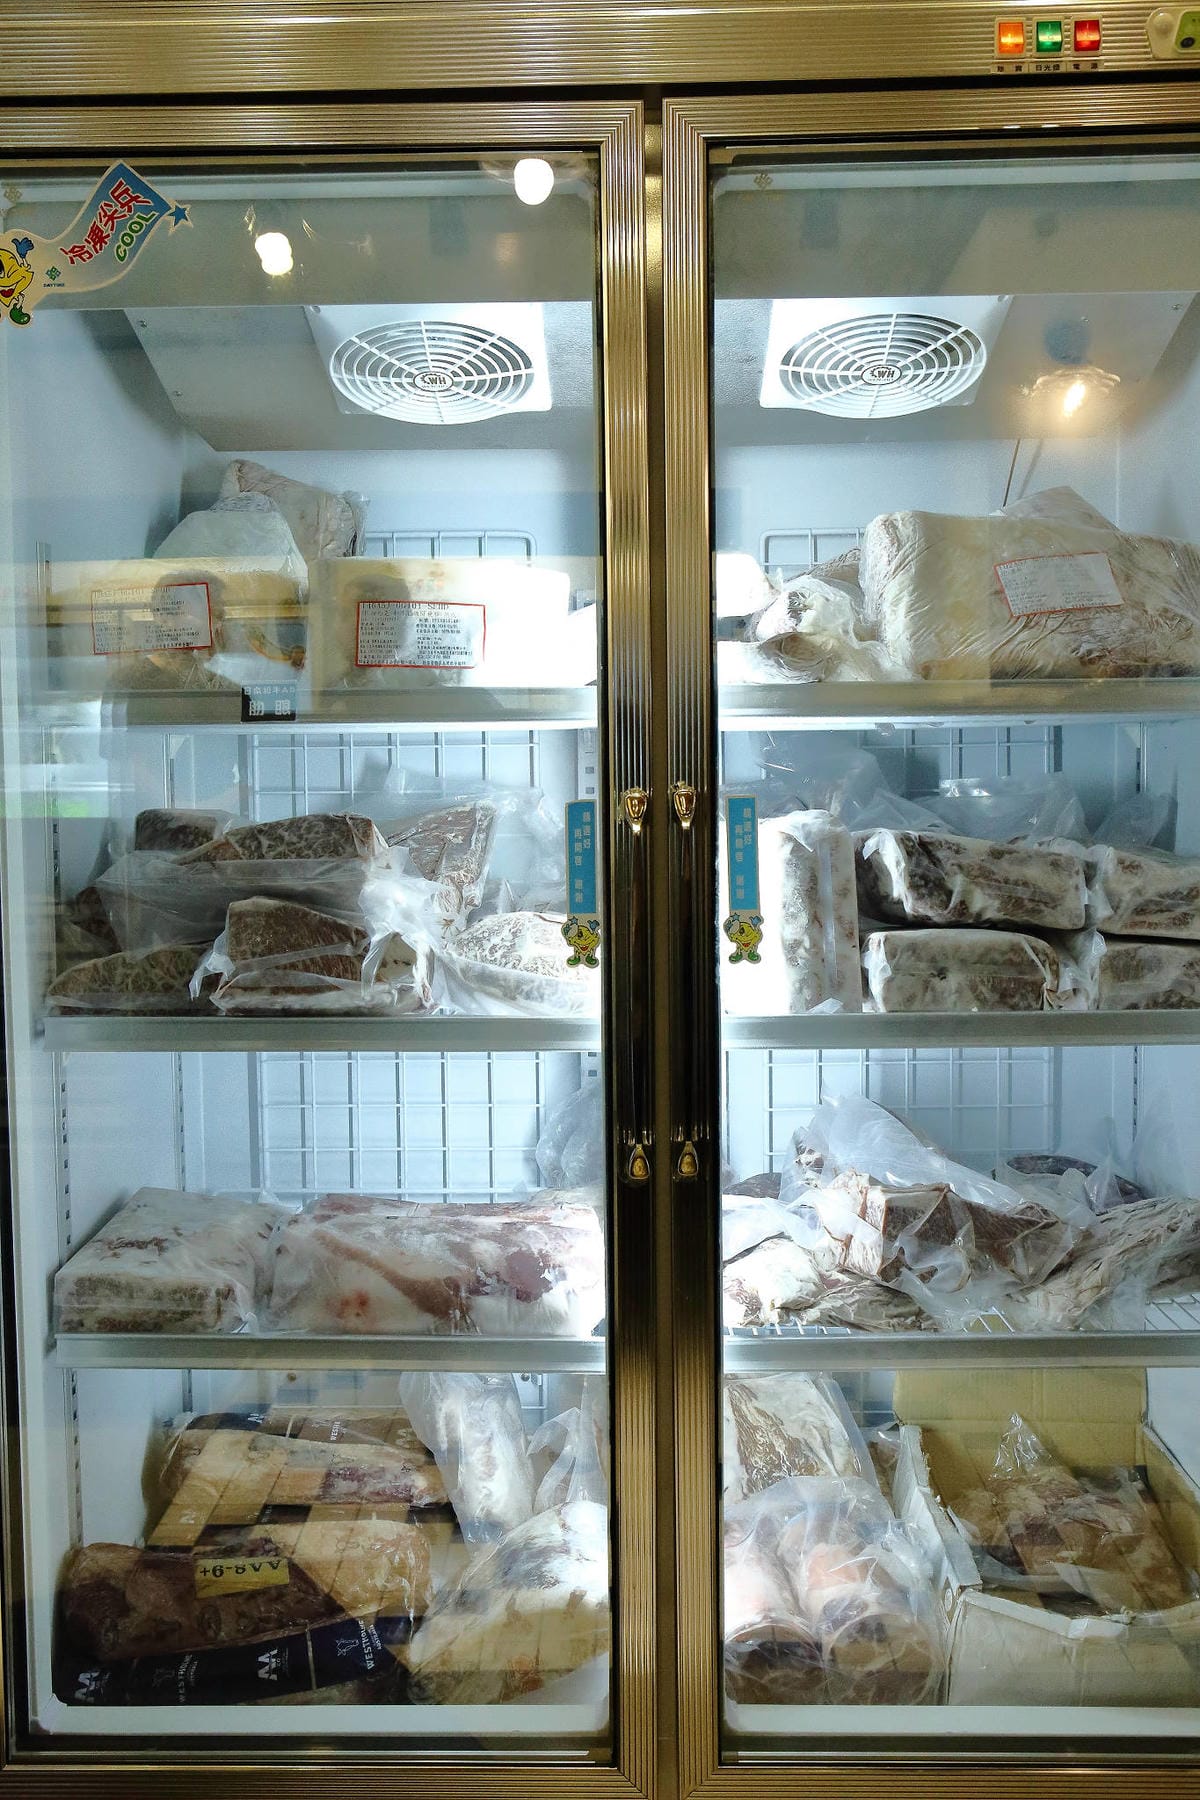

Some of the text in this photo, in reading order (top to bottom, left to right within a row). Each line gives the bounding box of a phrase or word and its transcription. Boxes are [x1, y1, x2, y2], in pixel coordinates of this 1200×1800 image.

[60, 178, 153, 265] 冷凍尖兵
[115, 211, 158, 264] COOL
